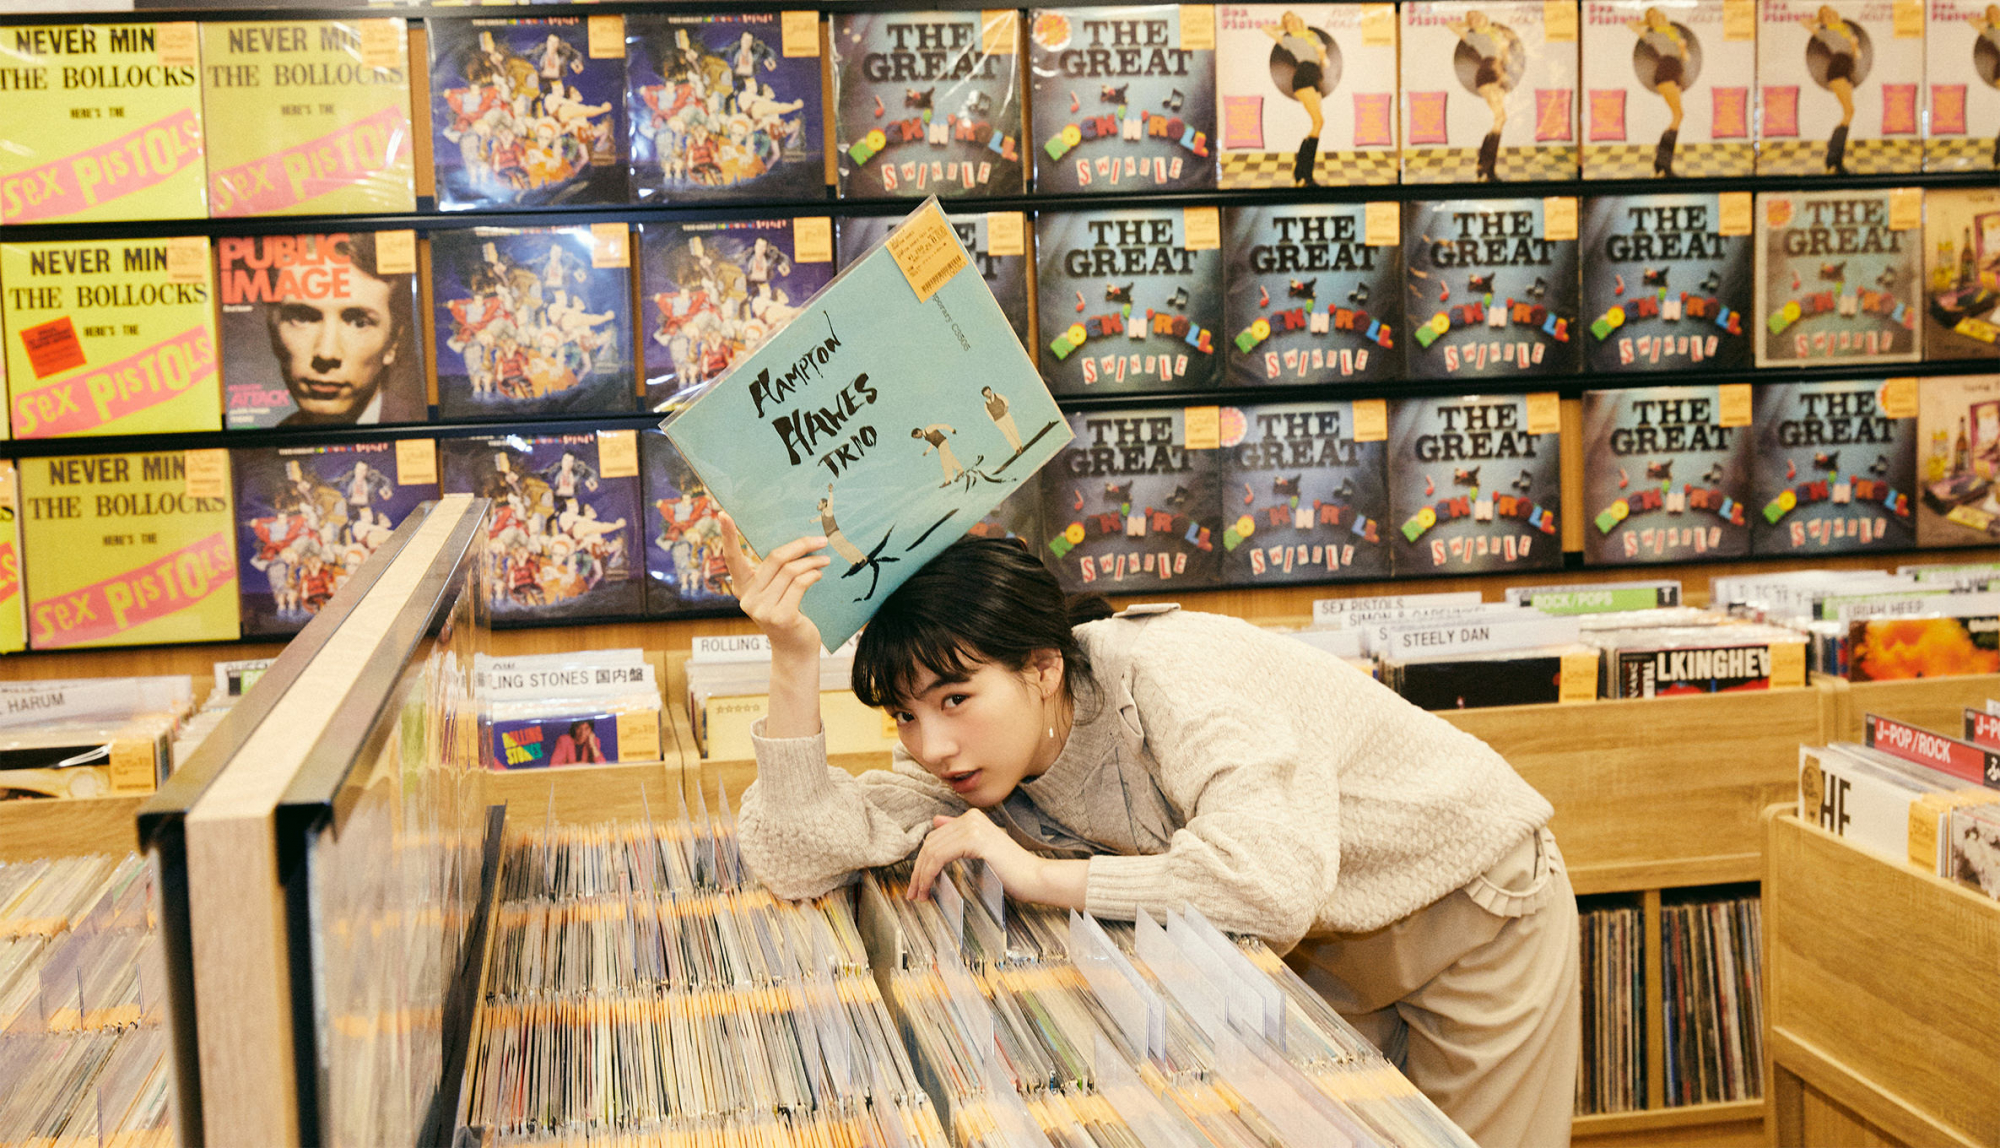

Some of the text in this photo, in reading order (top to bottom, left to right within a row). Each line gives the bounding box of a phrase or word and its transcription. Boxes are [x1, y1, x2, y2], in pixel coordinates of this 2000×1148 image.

[15, 29, 97, 54] NEVER
[110, 28, 155, 52] MIN
[228, 26, 307, 53] NEVER
[886, 21, 974, 50] THE
[1083, 20, 1168, 46] THE
[208, 63, 403, 87] THE BOLLOCKS
[863, 51, 1000, 82] GREAT
[1058, 48, 1194, 77] GREAT
[0, 65, 195, 90] THE BOLLOCKS
[109, 106, 125, 118] THE
[319, 104, 335, 115] THE
[1453, 211, 1533, 238] THE
[1629, 205, 1707, 232] THE
[1805, 200, 1885, 227] THE
[1088, 218, 1173, 247] THE
[1273, 215, 1355, 243] THE
[1784, 226, 1909, 256] GREAT
[31, 247, 167, 276] NEVER MIN
[218, 233, 351, 270] PUBLIC
[1250, 243, 1379, 274] GREAT
[1430, 238, 1557, 267] GREAT
[1606, 232, 1731, 262] GREAT
[1064, 247, 1197, 278] GREAT
[10, 282, 208, 310] THE BOLLOCKS
[220, 267, 351, 304] IMAGE
[123, 325, 139, 336] THE
[749, 310, 841, 419] HAMPTON
[772, 372, 878, 466] HAWES
[1438, 404, 1518, 432] THE
[1632, 398, 1712, 426] THE
[1800, 391, 1876, 418] THE
[1086, 417, 1173, 447] THE
[1256, 410, 1340, 440] THE
[1610, 424, 1735, 455] GREAT
[1779, 417, 1898, 446] GREAT
[817, 425, 878, 479] TRIO
[1066, 446, 1197, 476] GREAT
[1239, 439, 1361, 470] GREAT
[1415, 431, 1541, 462] GREAT
[50, 456, 186, 485] NEVER MIN
[28, 497, 81, 519] THE
[96, 494, 227, 517] BOLLOCKS
[141, 533, 157, 545] THE
[701, 638, 760, 652] ROLLING
[1404, 628, 1490, 647] STEELY DAN
[530, 671, 589, 687] STONES
[596, 667, 643, 684] 国内盤
[9, 692, 65, 713] HARUM
[1876, 720, 1951, 763] J-POP/ROCK
